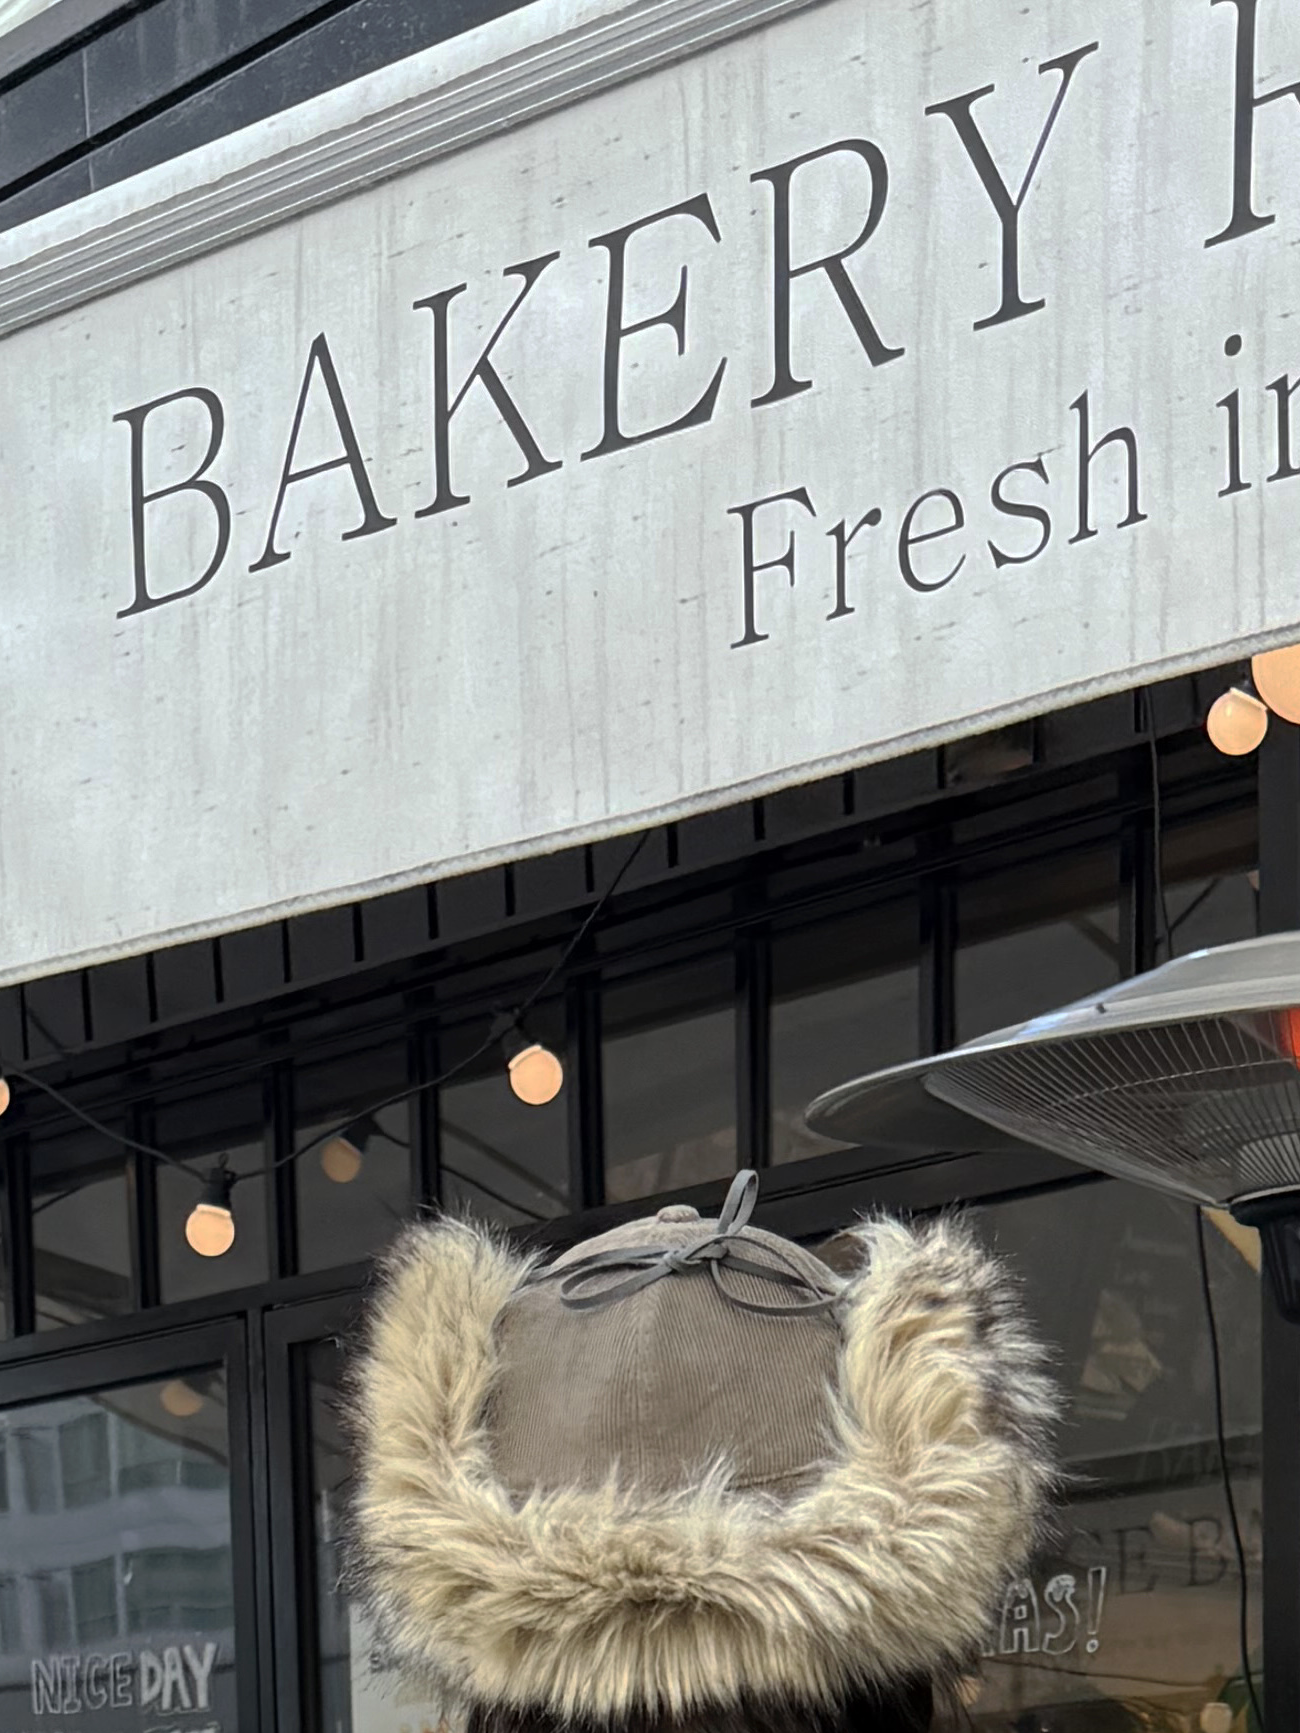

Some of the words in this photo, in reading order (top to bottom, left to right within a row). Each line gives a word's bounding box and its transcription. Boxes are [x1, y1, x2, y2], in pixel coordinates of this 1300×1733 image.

[111, 40, 1101, 620] BAKERY
[726, 388, 1149, 650] Fresh
[31, 1653, 133, 1714] NICE
[138, 1641, 218, 1715] DAY
